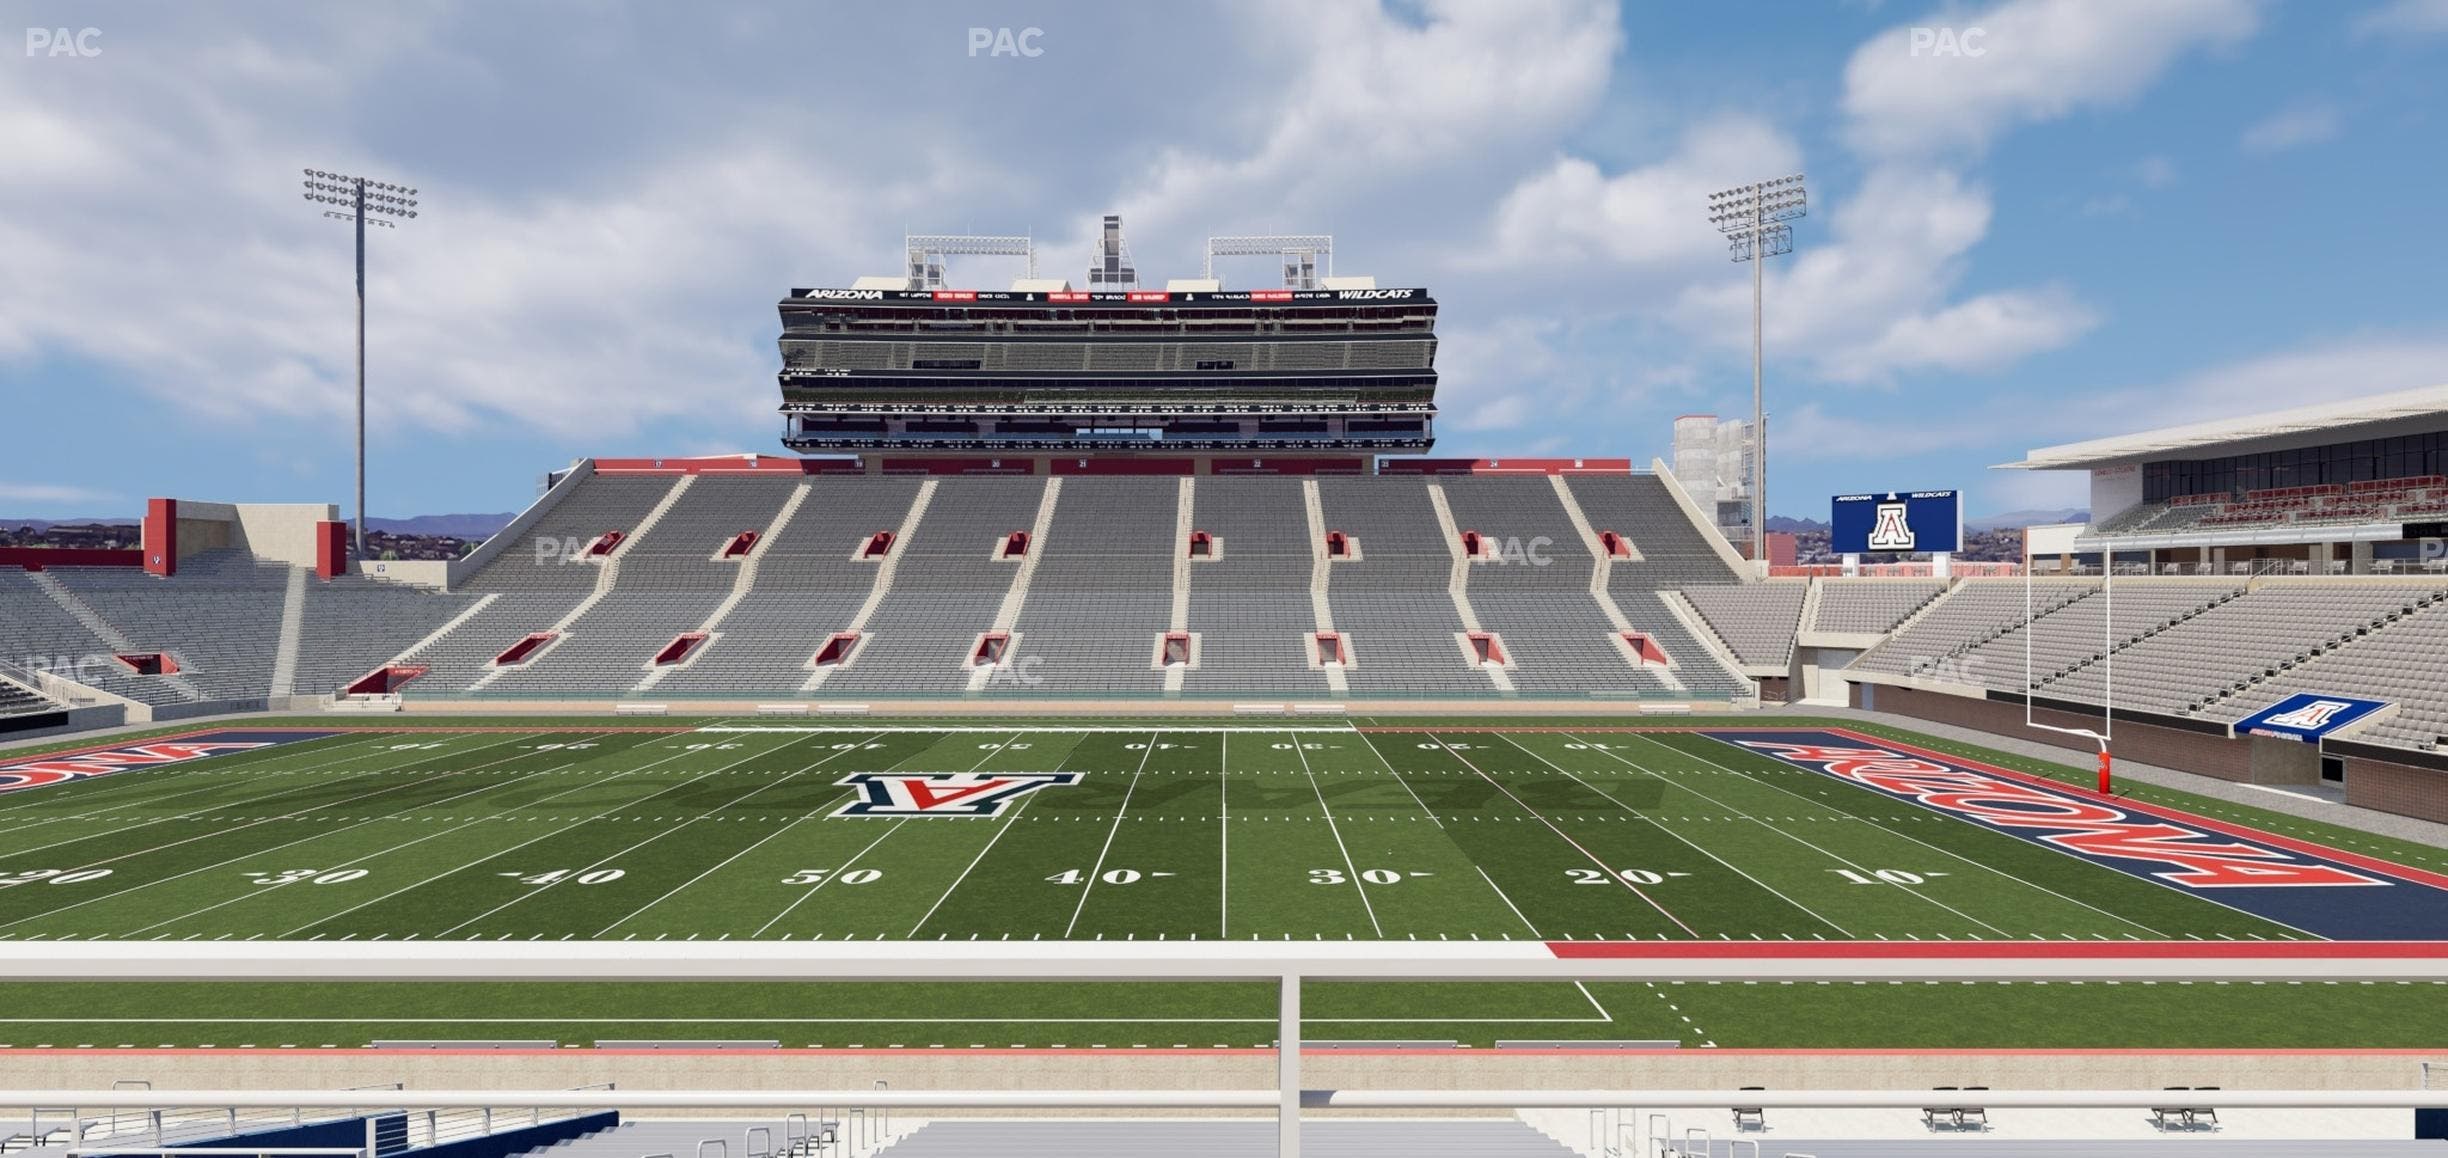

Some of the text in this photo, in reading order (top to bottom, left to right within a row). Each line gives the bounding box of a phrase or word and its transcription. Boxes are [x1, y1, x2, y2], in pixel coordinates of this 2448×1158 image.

[805, 289, 883, 300] ARIZONA
[1338, 289, 1413, 300] WILDCATS
[1911, 491, 1952, 499] WILDCATS
[1869, 504, 1914, 549] A
[828, 772, 1085, 818] A
[1735, 738, 2395, 888] ARIZONA
[253, 869, 369, 885] 30
[519, 869, 626, 885] 40
[781, 869, 883, 885] 50
[1045, 869, 1141, 885] 40
[1308, 869, 1401, 885] 30
[1564, 869, 1664, 885] 20
[1826, 869, 1925, 885] 10
